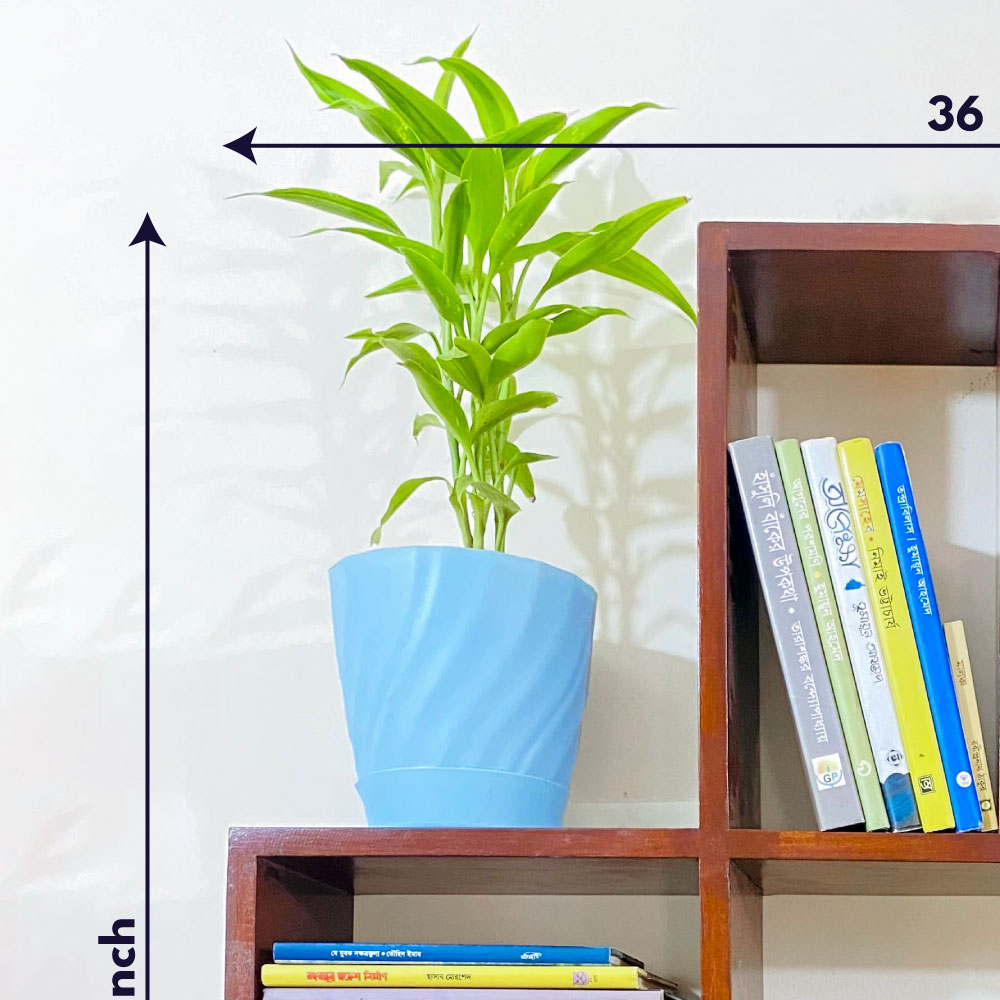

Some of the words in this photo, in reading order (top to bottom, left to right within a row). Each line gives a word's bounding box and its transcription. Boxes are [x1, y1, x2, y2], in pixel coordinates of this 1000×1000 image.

[751, 469, 778, 510] হাঁসুলি
[762, 511, 791, 552] বাঁকের
[852, 475, 874, 532] মেমসাহেব
[869, 547, 889, 582] নিমাই
[772, 554, 799, 604] উপকথা
[789, 479, 808, 520] আগুনের
[824, 621, 843, 661] আহমেদ
[792, 622, 811, 671] তারাশঙ্কর
[804, 675, 830, 743] বন্দ্যোপাধ্যায়
[822, 772, 839, 783] GP
